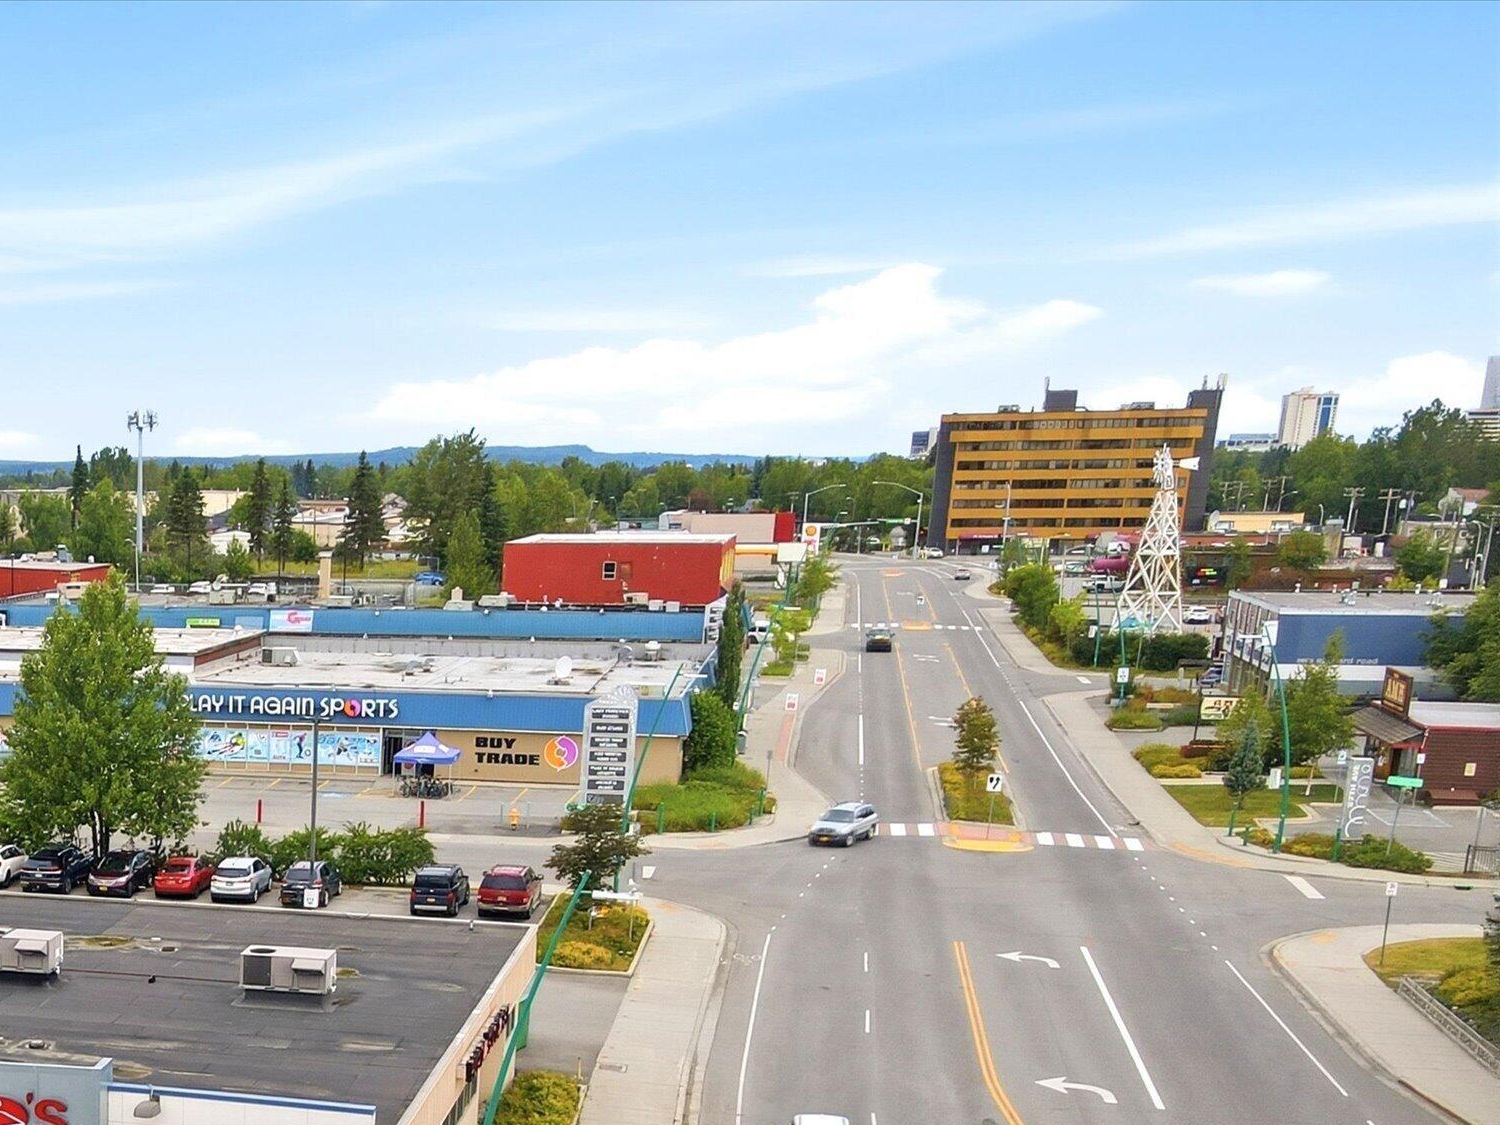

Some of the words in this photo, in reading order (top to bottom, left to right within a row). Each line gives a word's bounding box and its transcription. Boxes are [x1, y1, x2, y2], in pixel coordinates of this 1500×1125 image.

[228, 694, 246, 714] IT
[250, 696, 314, 716] AGAIN
[320, 698, 399, 719] SPORTS
[475, 736, 516, 749] BUY
[475, 752, 540, 766] TRADE
